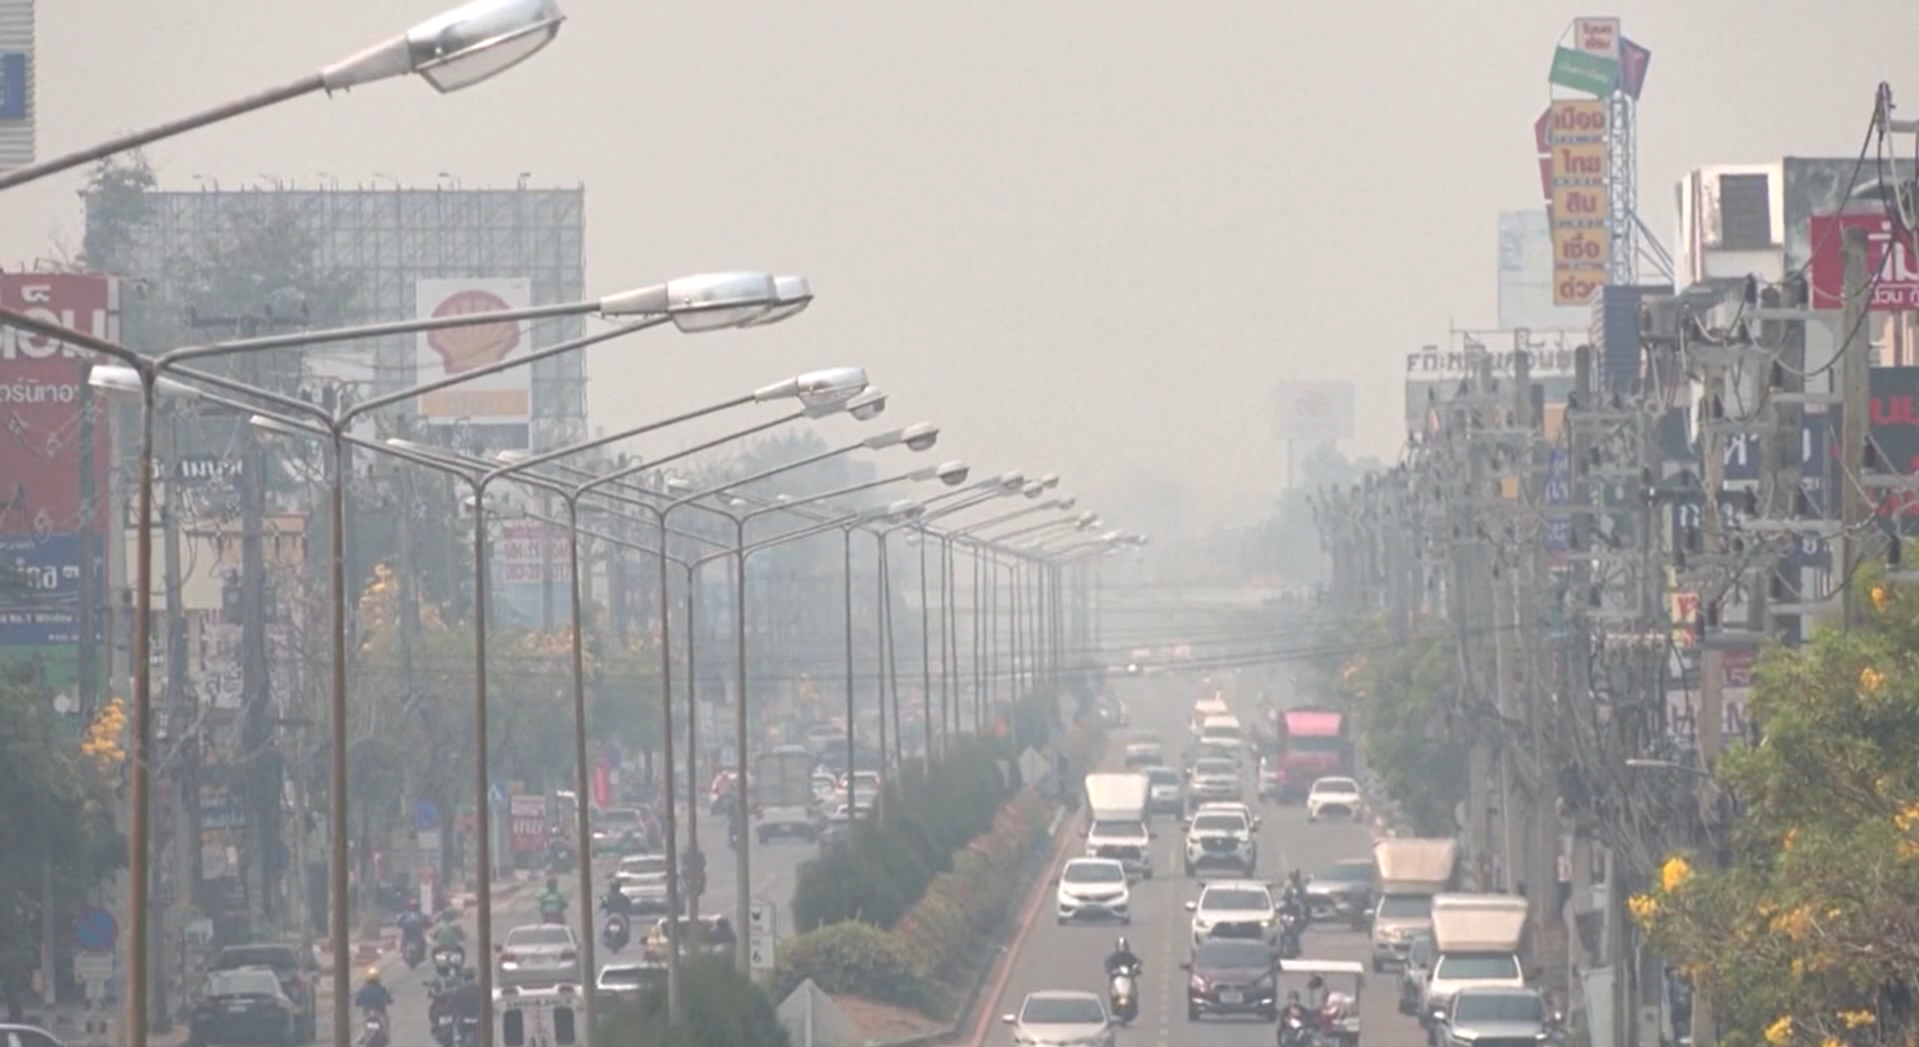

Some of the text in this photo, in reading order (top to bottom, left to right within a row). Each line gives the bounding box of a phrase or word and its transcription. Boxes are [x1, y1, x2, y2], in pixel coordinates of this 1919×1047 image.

[1554, 106, 1604, 130] เมือง
[1561, 149, 1601, 174] ไทย
[1566, 192, 1597, 214] สิน
[1564, 231, 1600, 259] เชื่อ
